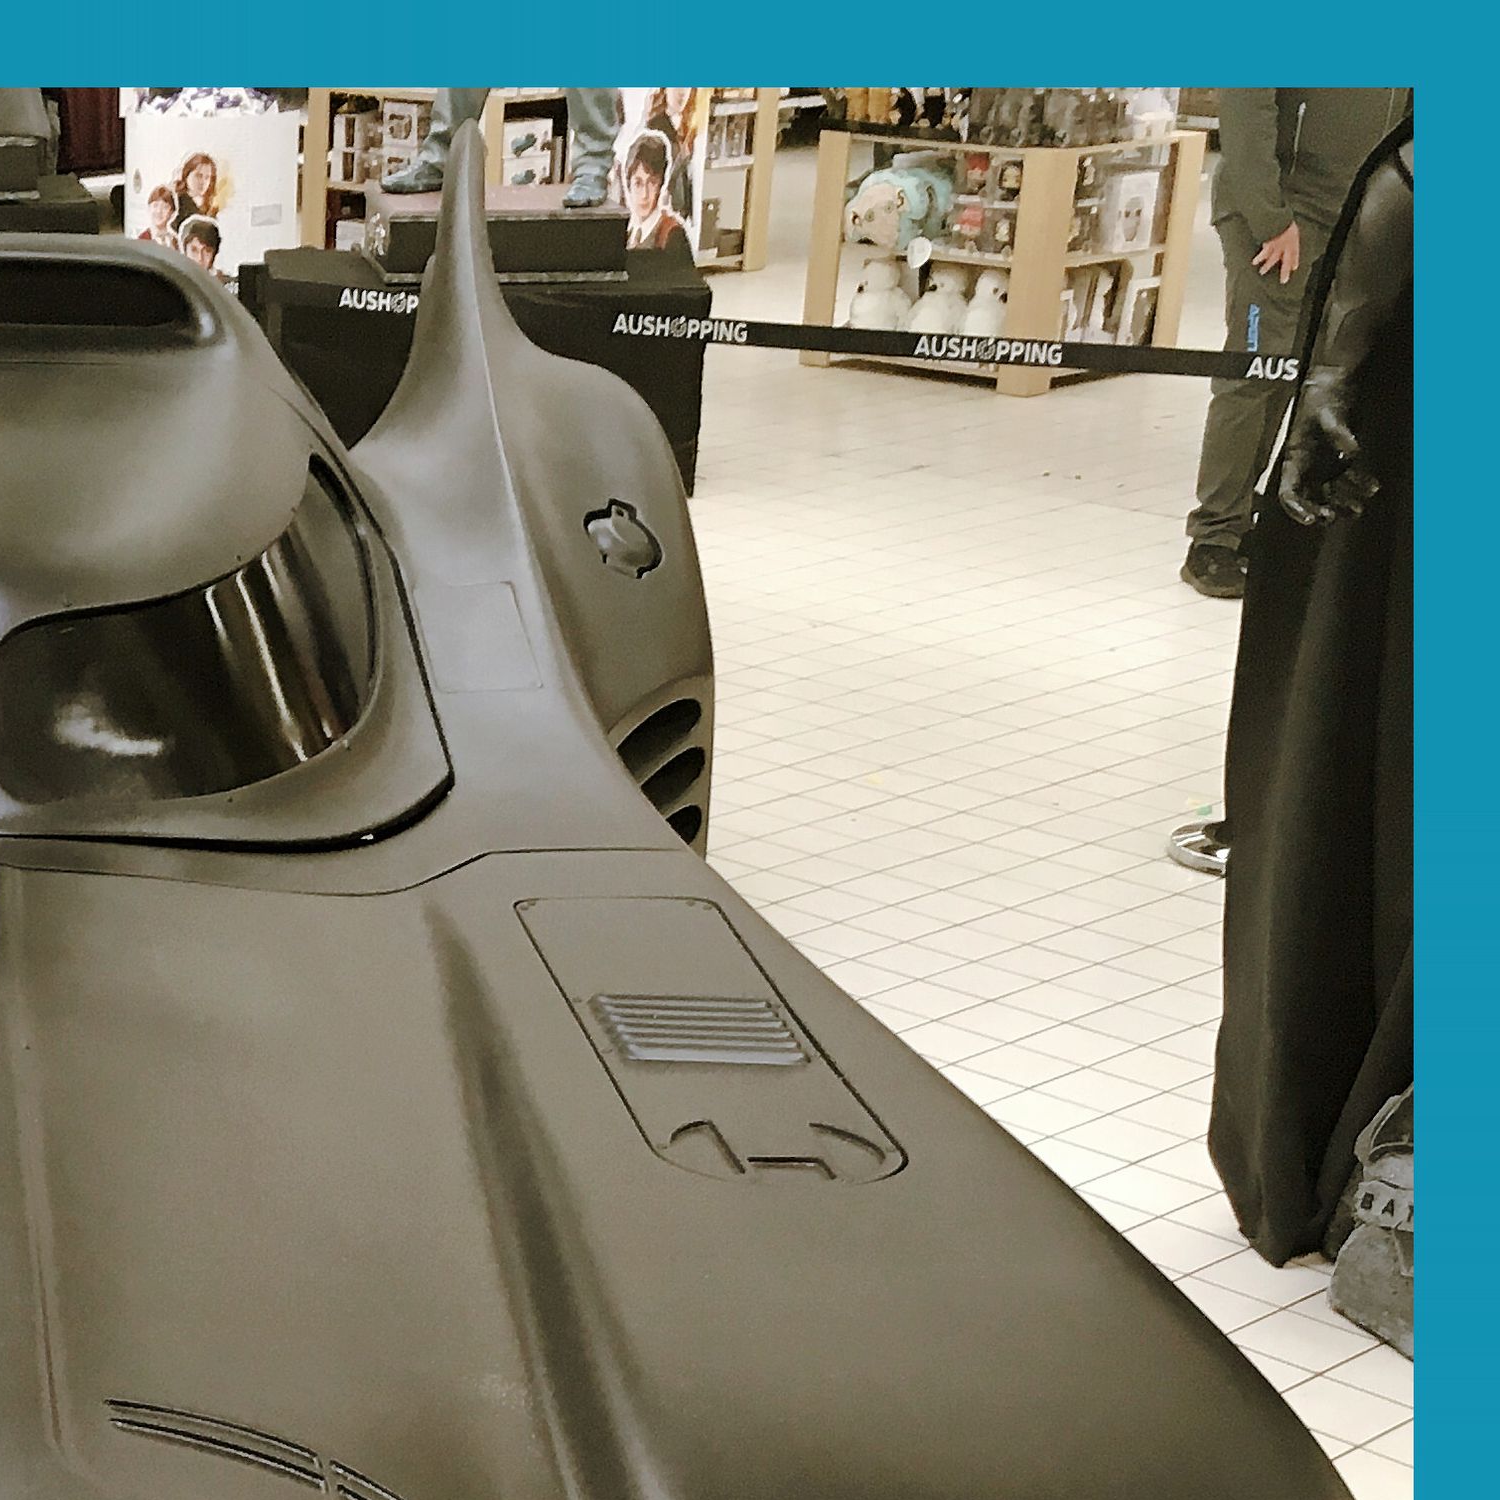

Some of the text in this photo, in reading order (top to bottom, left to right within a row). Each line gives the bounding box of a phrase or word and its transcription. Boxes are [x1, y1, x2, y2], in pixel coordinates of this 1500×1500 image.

[339, 287, 419, 315] AUSHOP
[612, 313, 749, 343] AUSHOPPING
[913, 335, 1064, 366] AUSHOPPING
[1245, 356, 1300, 382] AUS
